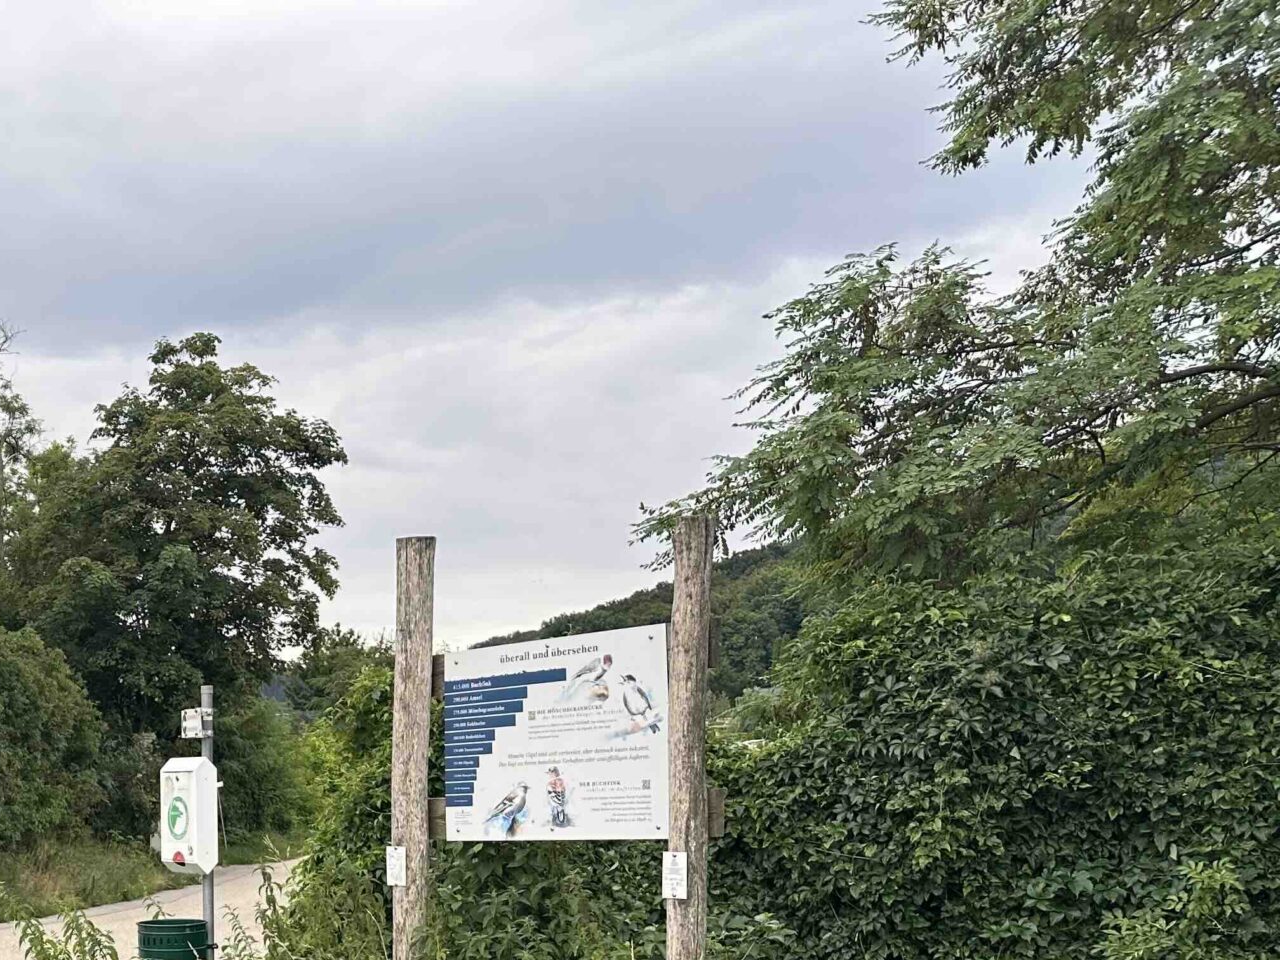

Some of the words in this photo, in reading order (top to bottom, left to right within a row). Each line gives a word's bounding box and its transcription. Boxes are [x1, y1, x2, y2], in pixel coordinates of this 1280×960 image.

[499, 651, 530, 663] überall
[532, 648, 549, 659] und
[551, 644, 598, 657] übersehen
